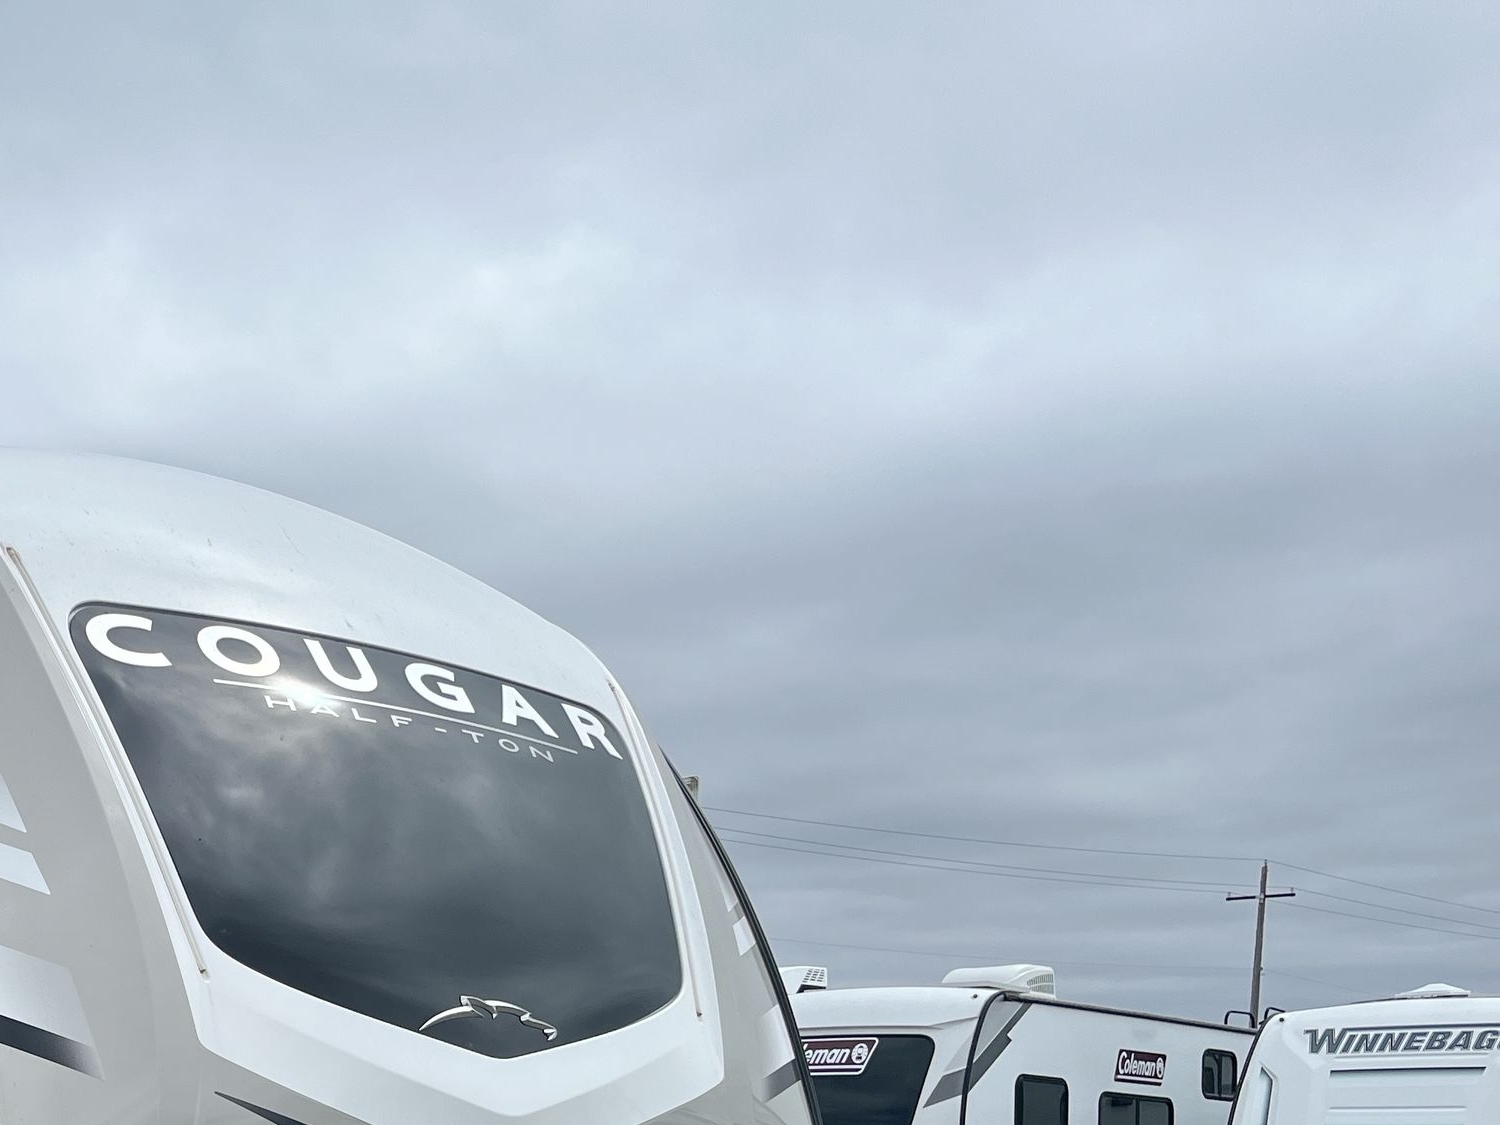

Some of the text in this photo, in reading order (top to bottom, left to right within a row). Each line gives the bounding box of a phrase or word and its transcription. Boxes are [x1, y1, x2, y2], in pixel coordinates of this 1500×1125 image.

[85, 613, 623, 760] COUGAR
[263, 694, 555, 763] HALF-TON
[802, 1043, 851, 1065] eman
[1303, 1028, 1500, 1055] WINNEBAG
[1118, 1051, 1156, 1077] Coleman
